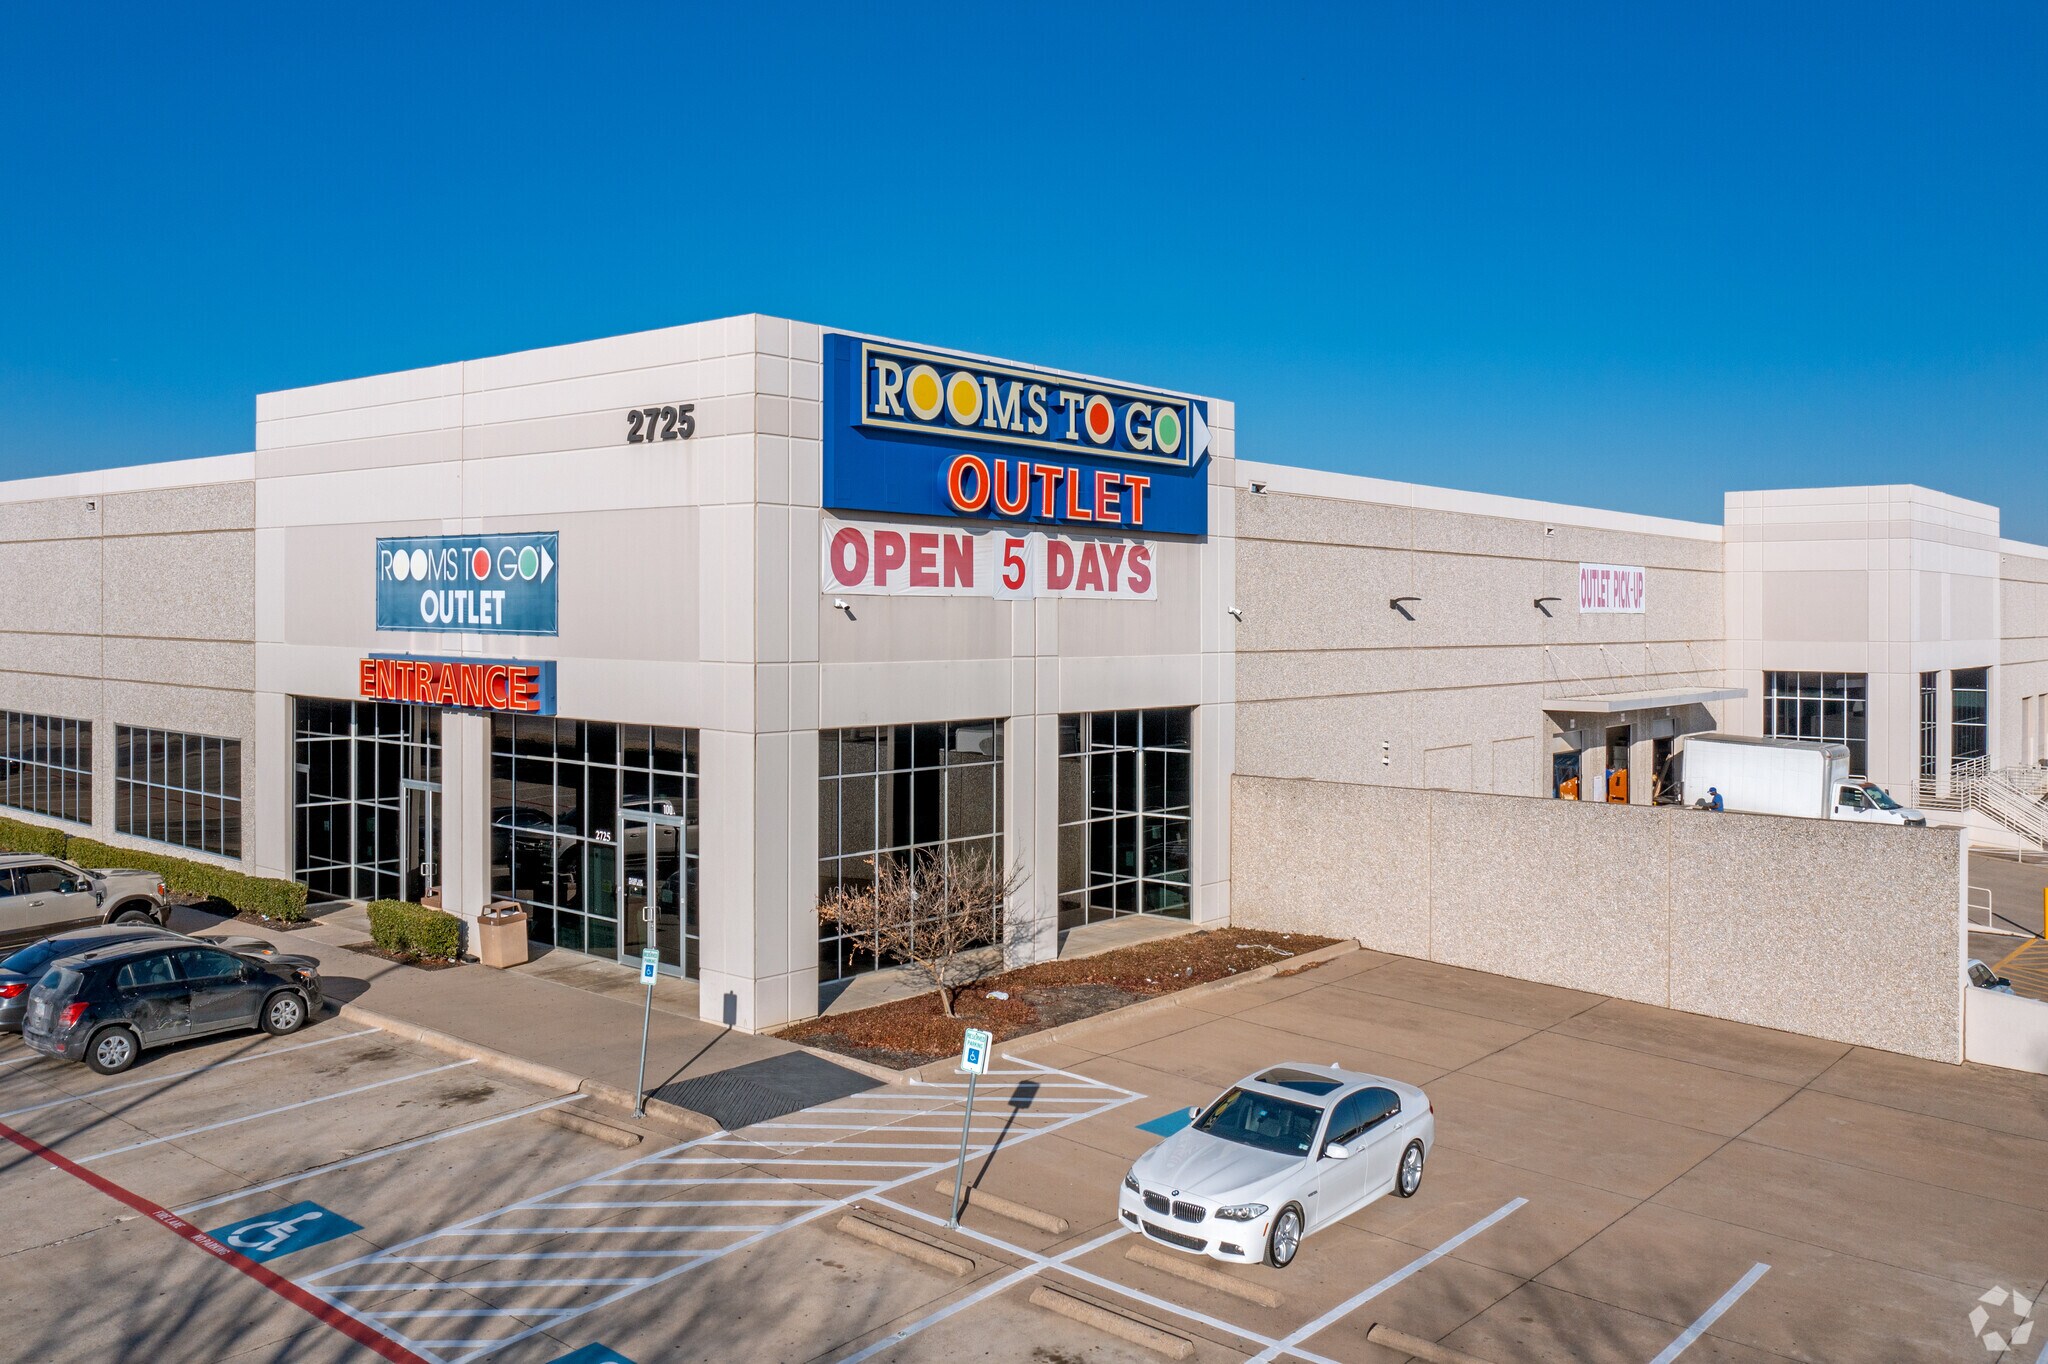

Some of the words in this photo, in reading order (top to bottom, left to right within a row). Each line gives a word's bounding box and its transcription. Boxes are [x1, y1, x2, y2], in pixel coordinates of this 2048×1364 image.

[627, 404, 695, 444] 2725
[874, 358, 1048, 435] ROOMS
[1059, 391, 1115, 445] TO
[1125, 402, 1181, 454] GO
[948, 454, 1150, 525] OUTLET
[381, 548, 458, 581] ROOMS
[462, 547, 491, 581] TO
[497, 545, 539, 581] GO
[830, 527, 974, 588] OPEN
[1002, 538, 1026, 590] 5
[1047, 539, 1151, 594] DAYS
[420, 589, 506, 625] OUTLET
[1581, 568, 1610, 608] OUTLET
[1614, 570, 1643, 608] PICK-UP
[359, 658, 530, 711] ENTRANCE
[595, 830, 611, 842] 2725
[967, 1032, 986, 1042] RESERVED
[967, 1040, 984, 1049] PARKING
[153, 1210, 172, 1220] FIRE
[164, 1217, 187, 1229] LANE
[191, 1233, 207, 1242] NO
[199, 1238, 231, 1255] PARKING
